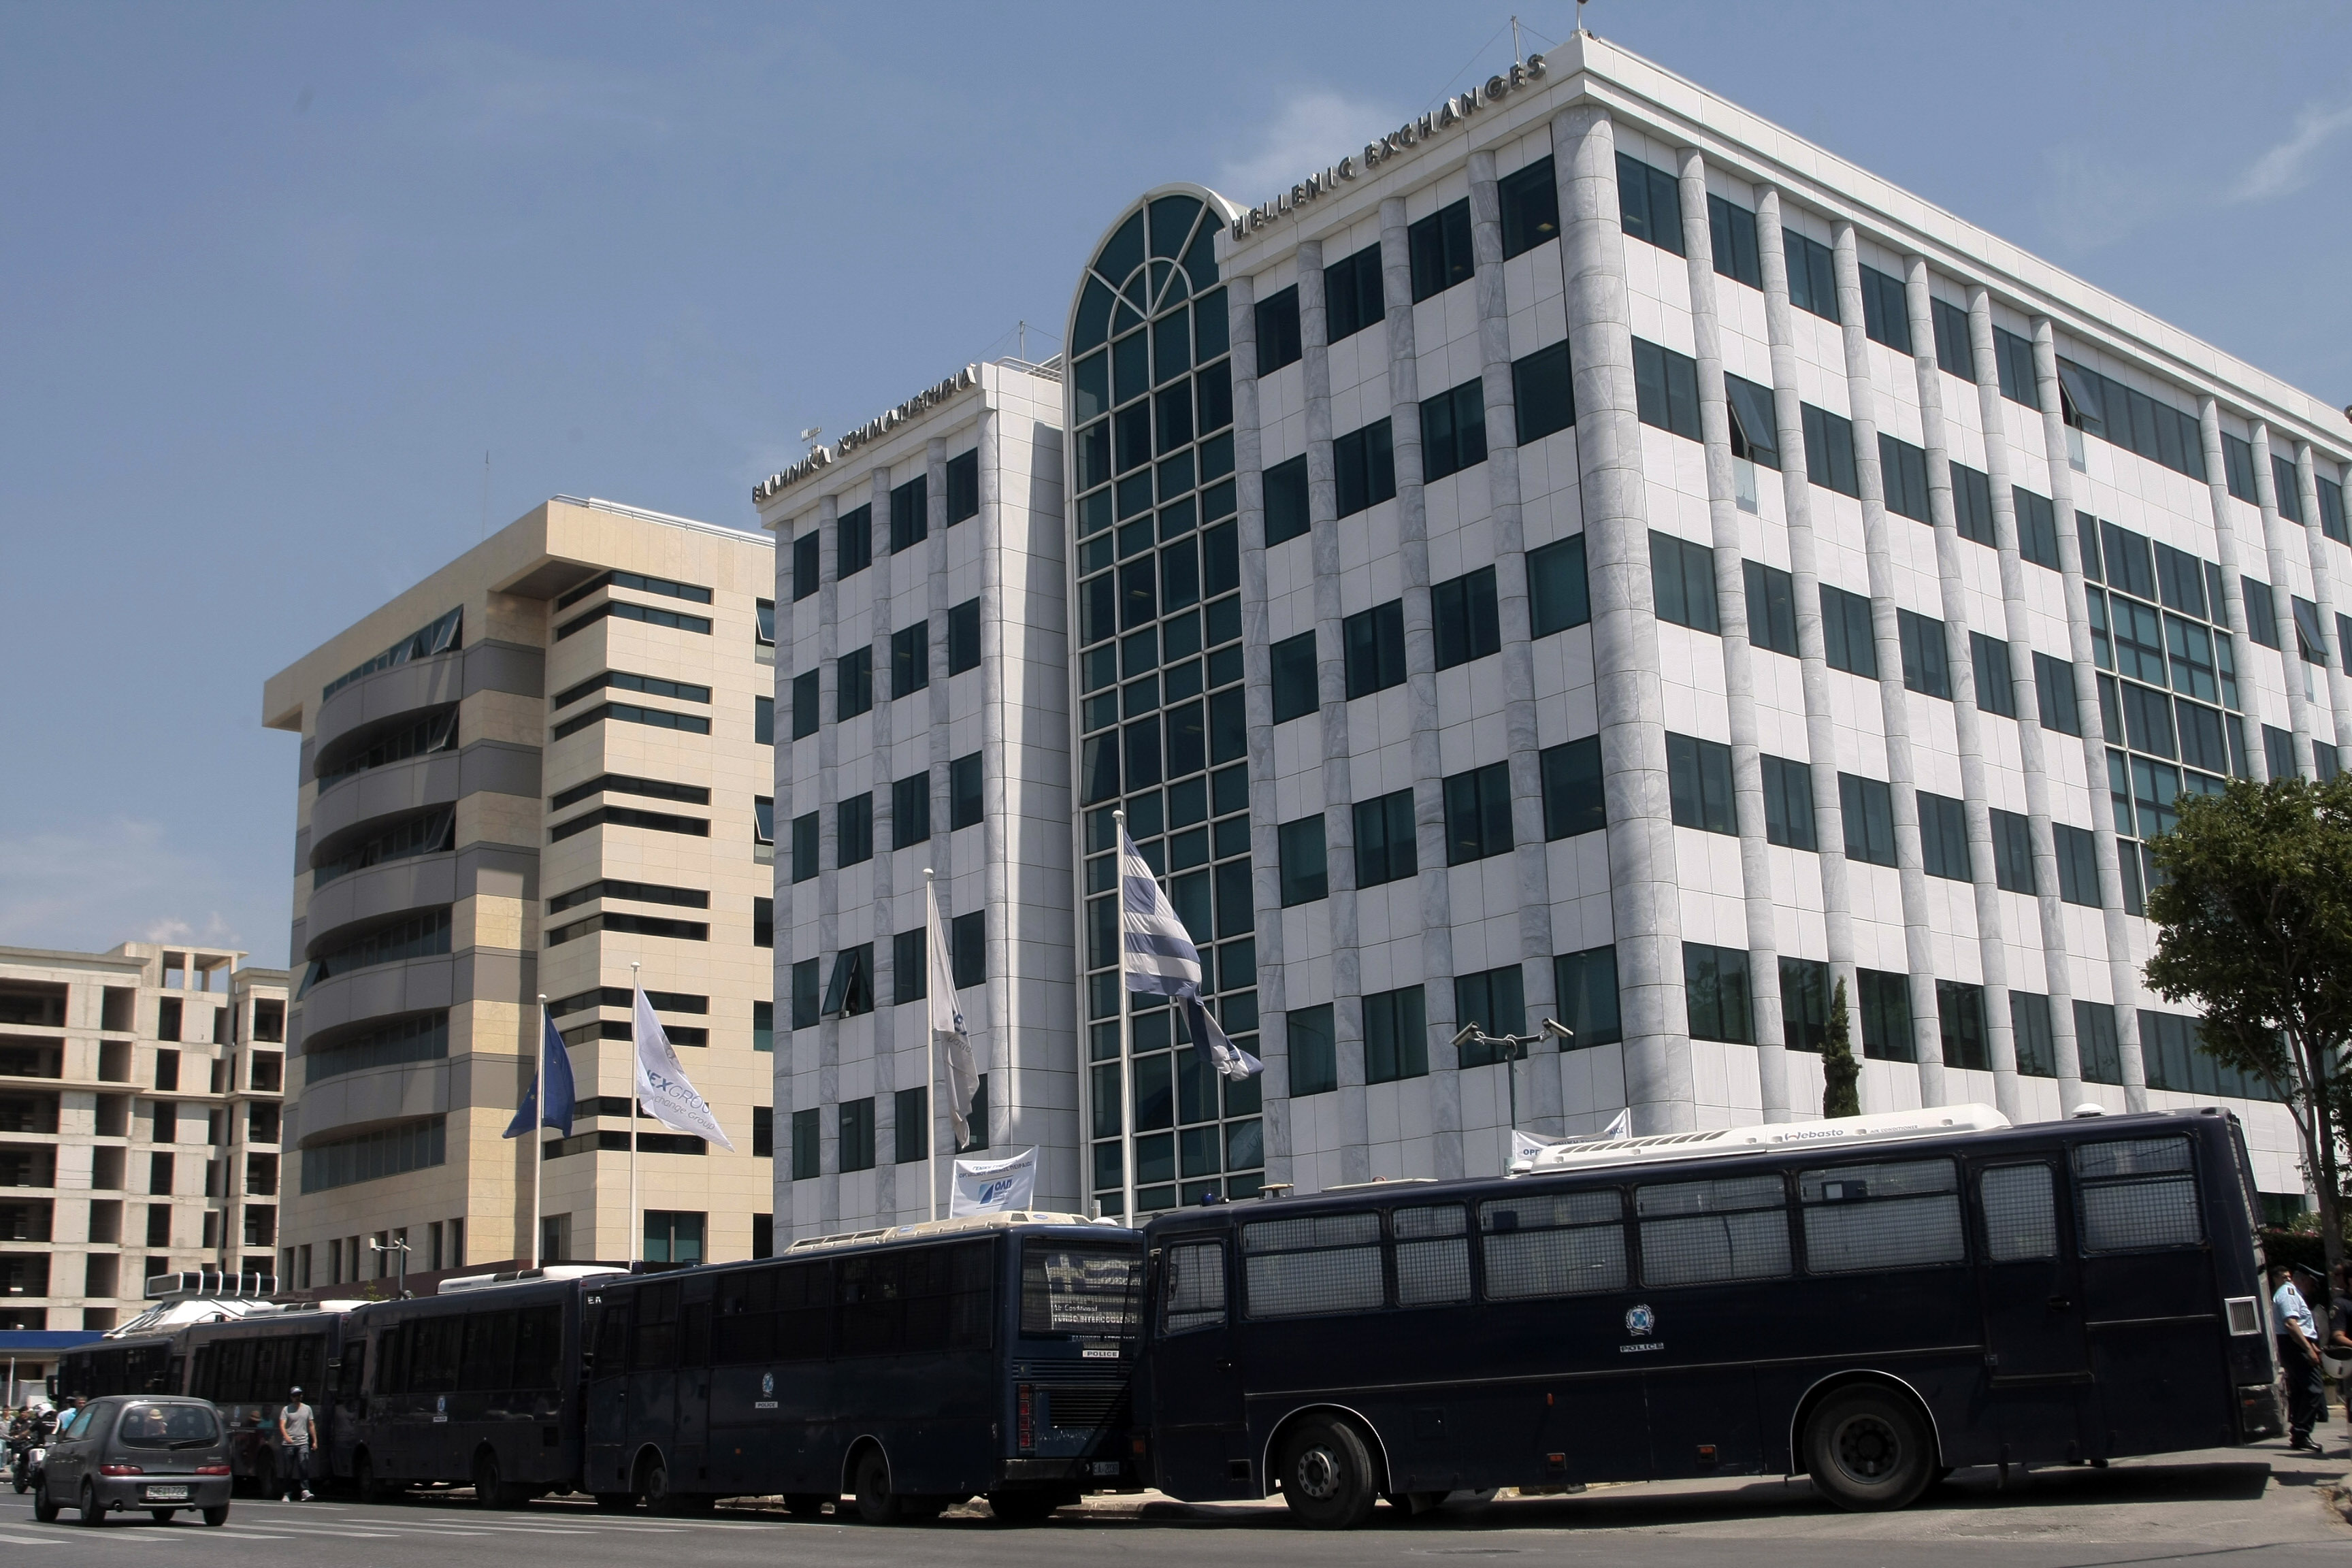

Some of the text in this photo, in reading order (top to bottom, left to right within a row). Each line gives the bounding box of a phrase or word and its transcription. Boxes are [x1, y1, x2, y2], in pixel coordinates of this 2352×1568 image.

[1232, 53, 1546, 241] HELLENIC EXCHANGES
[653, 1096, 716, 1130] change Group
[1784, 1129, 1844, 1141] Webasto
[1522, 1148, 1540, 1156] ΟΡΓ
[1621, 1343, 1663, 1352] POLICE
